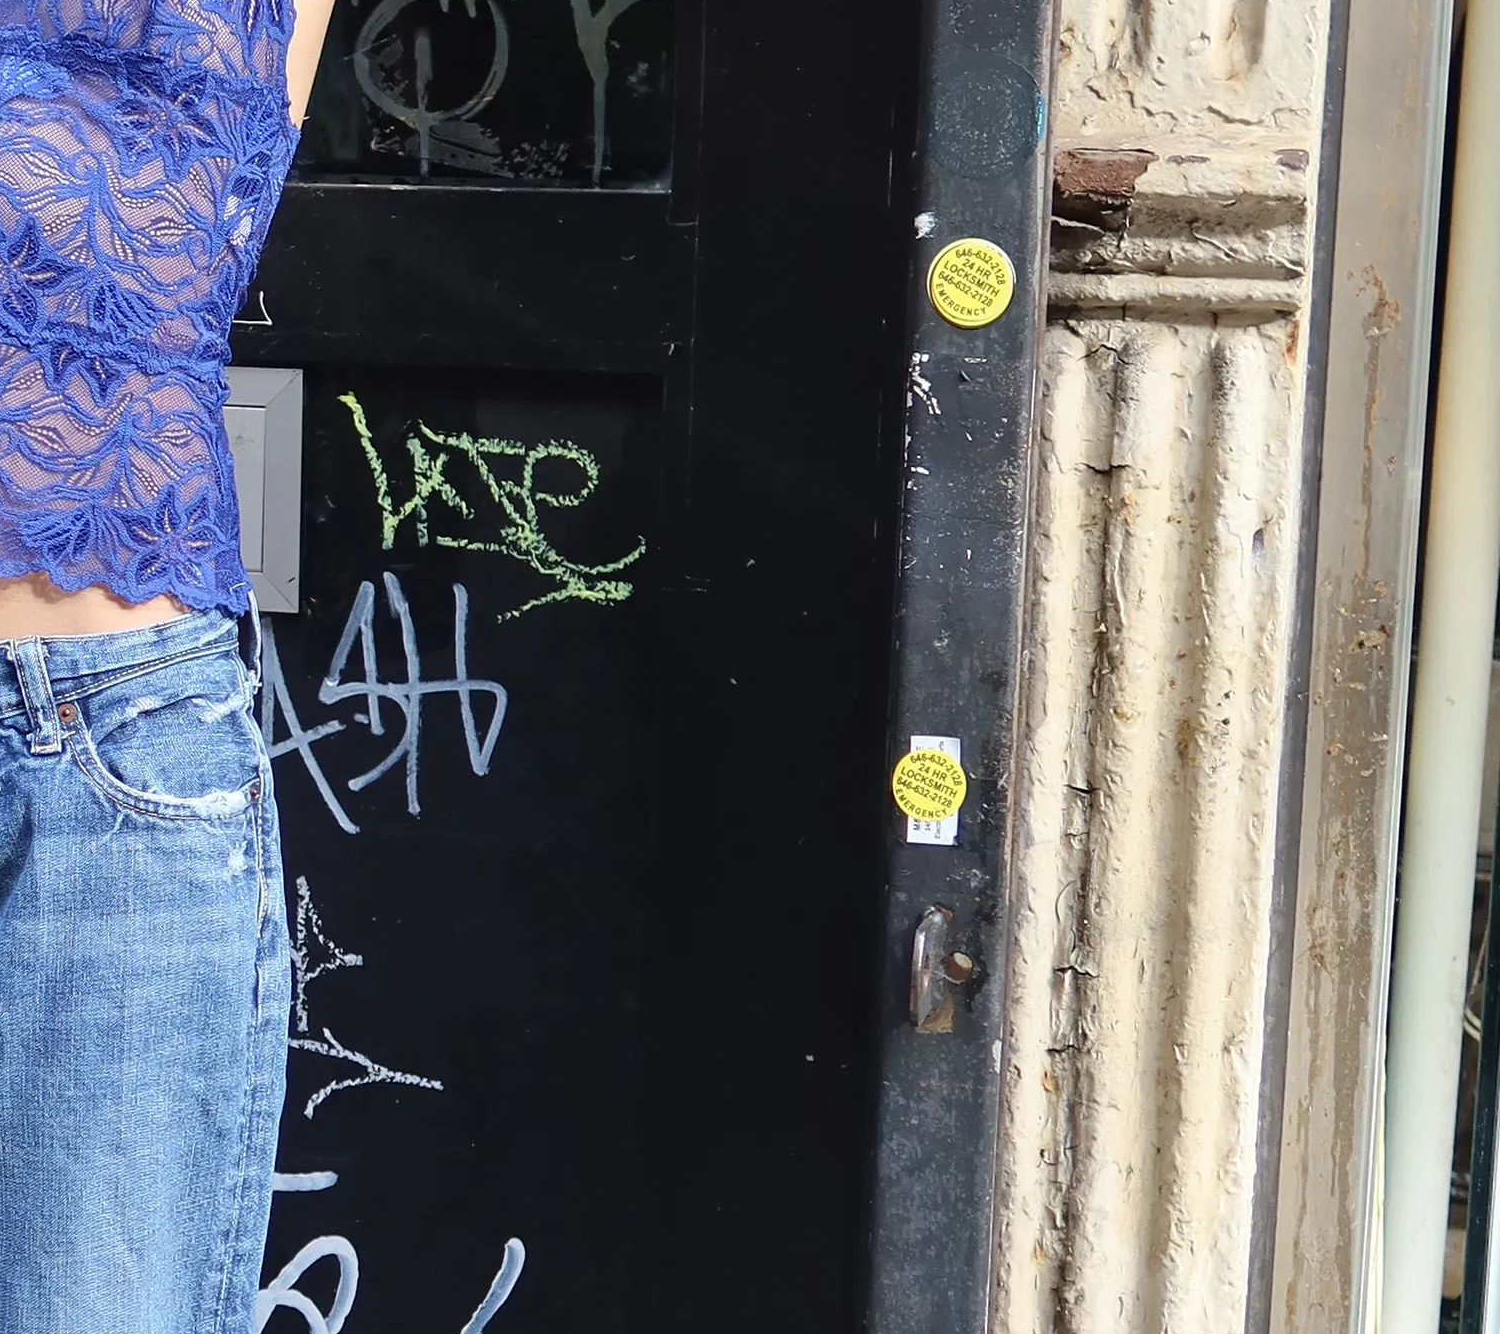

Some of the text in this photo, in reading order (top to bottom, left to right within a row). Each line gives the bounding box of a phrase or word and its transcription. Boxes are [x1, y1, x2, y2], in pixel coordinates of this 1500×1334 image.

[944, 260, 1000, 297] LOCKSMITH
[955, 248, 1006, 285] 646-632-2128
[963, 258, 991, 280] 24 HR
[936, 283, 986, 316] EMERGENCY
[938, 271, 993, 307] 646-632-2128
[900, 767, 958, 798] LOCKSMITH
[910, 753, 963, 786] 646-632-2128
[918, 763, 947, 781] 24 HR
[895, 788, 947, 819] EMERGENCY
[896, 776, 953, 808] 646-632-2128
